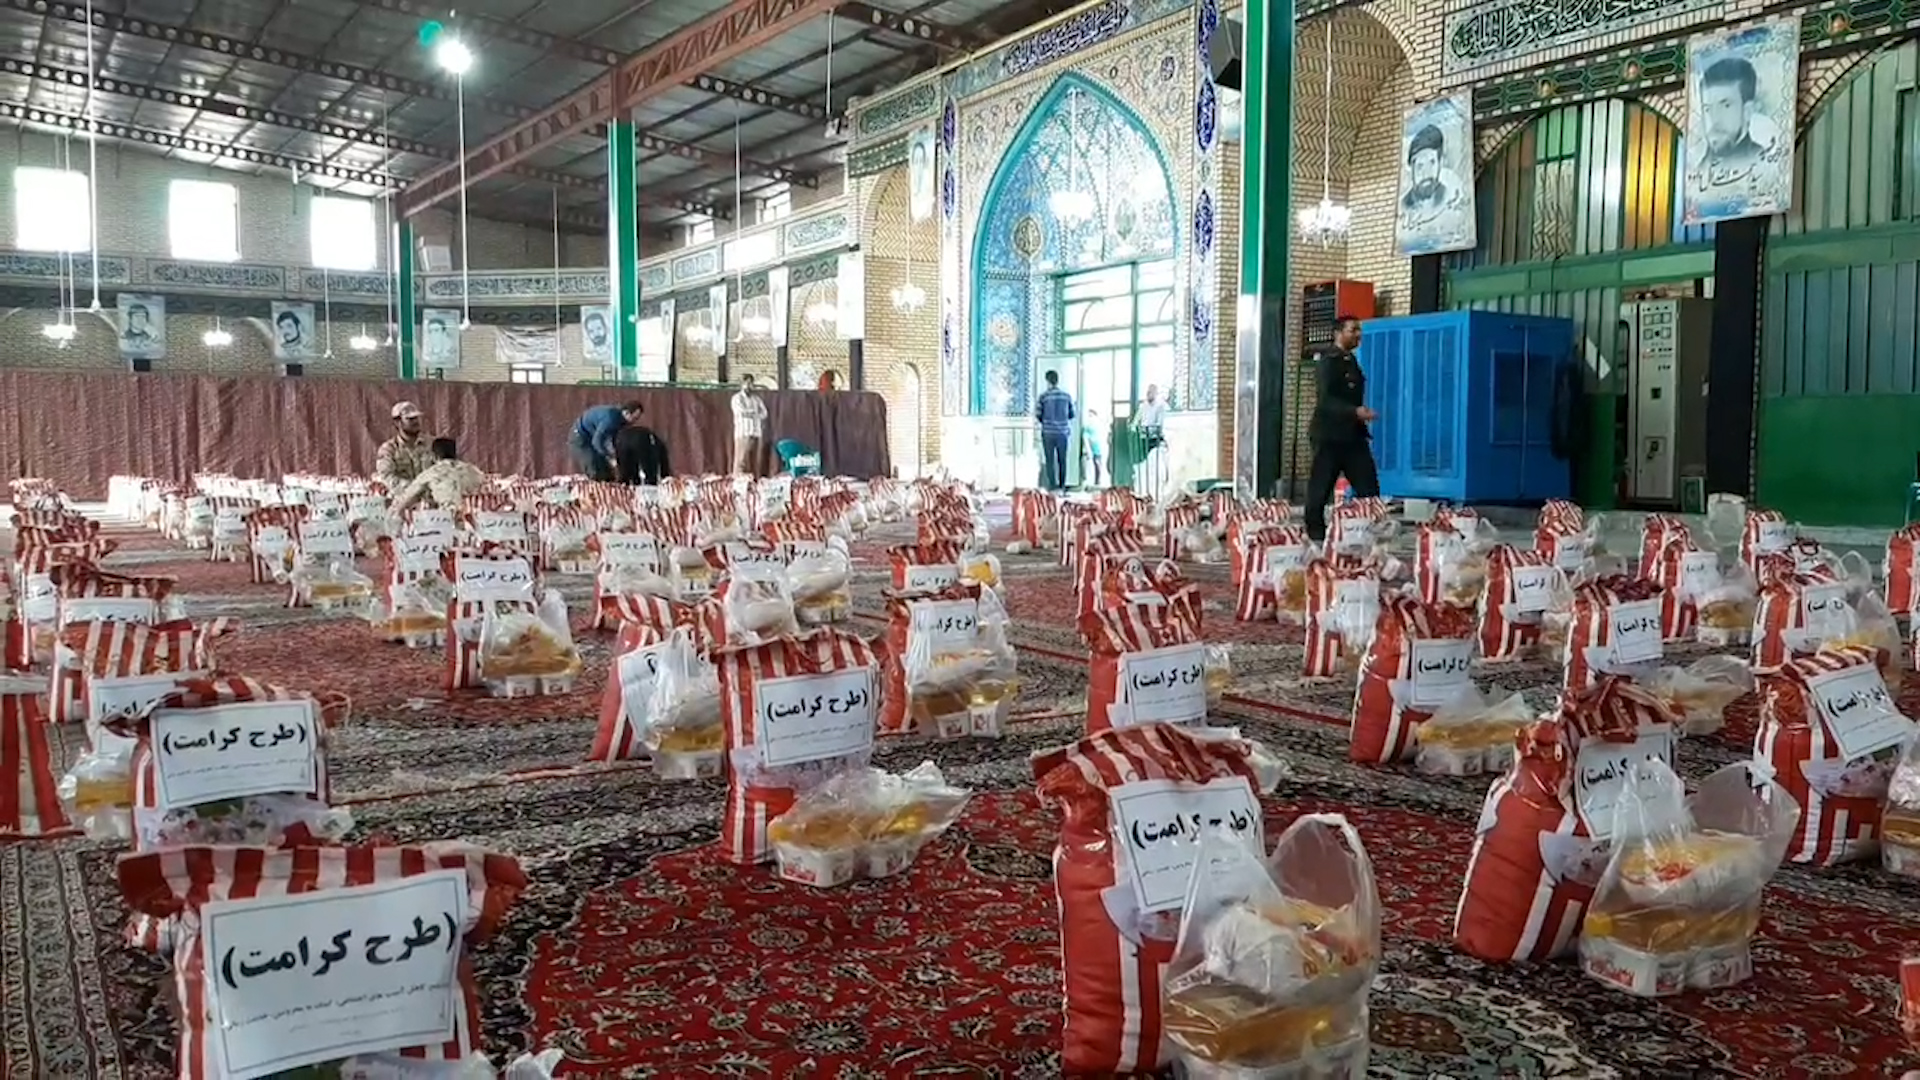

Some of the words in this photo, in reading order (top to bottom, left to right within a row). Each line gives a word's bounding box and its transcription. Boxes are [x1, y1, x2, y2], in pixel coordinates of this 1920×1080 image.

[1132, 667, 1179, 691] کرامت)
[1181, 663, 1205, 685] (طرح
[766, 694, 824, 723] کرامت)
[828, 687, 869, 714] (طرح
[162, 726, 242, 755] کرامت)
[248, 722, 307, 748] (طرح
[363, 911, 458, 966] (طرح
[220, 928, 353, 990] کرامت)
